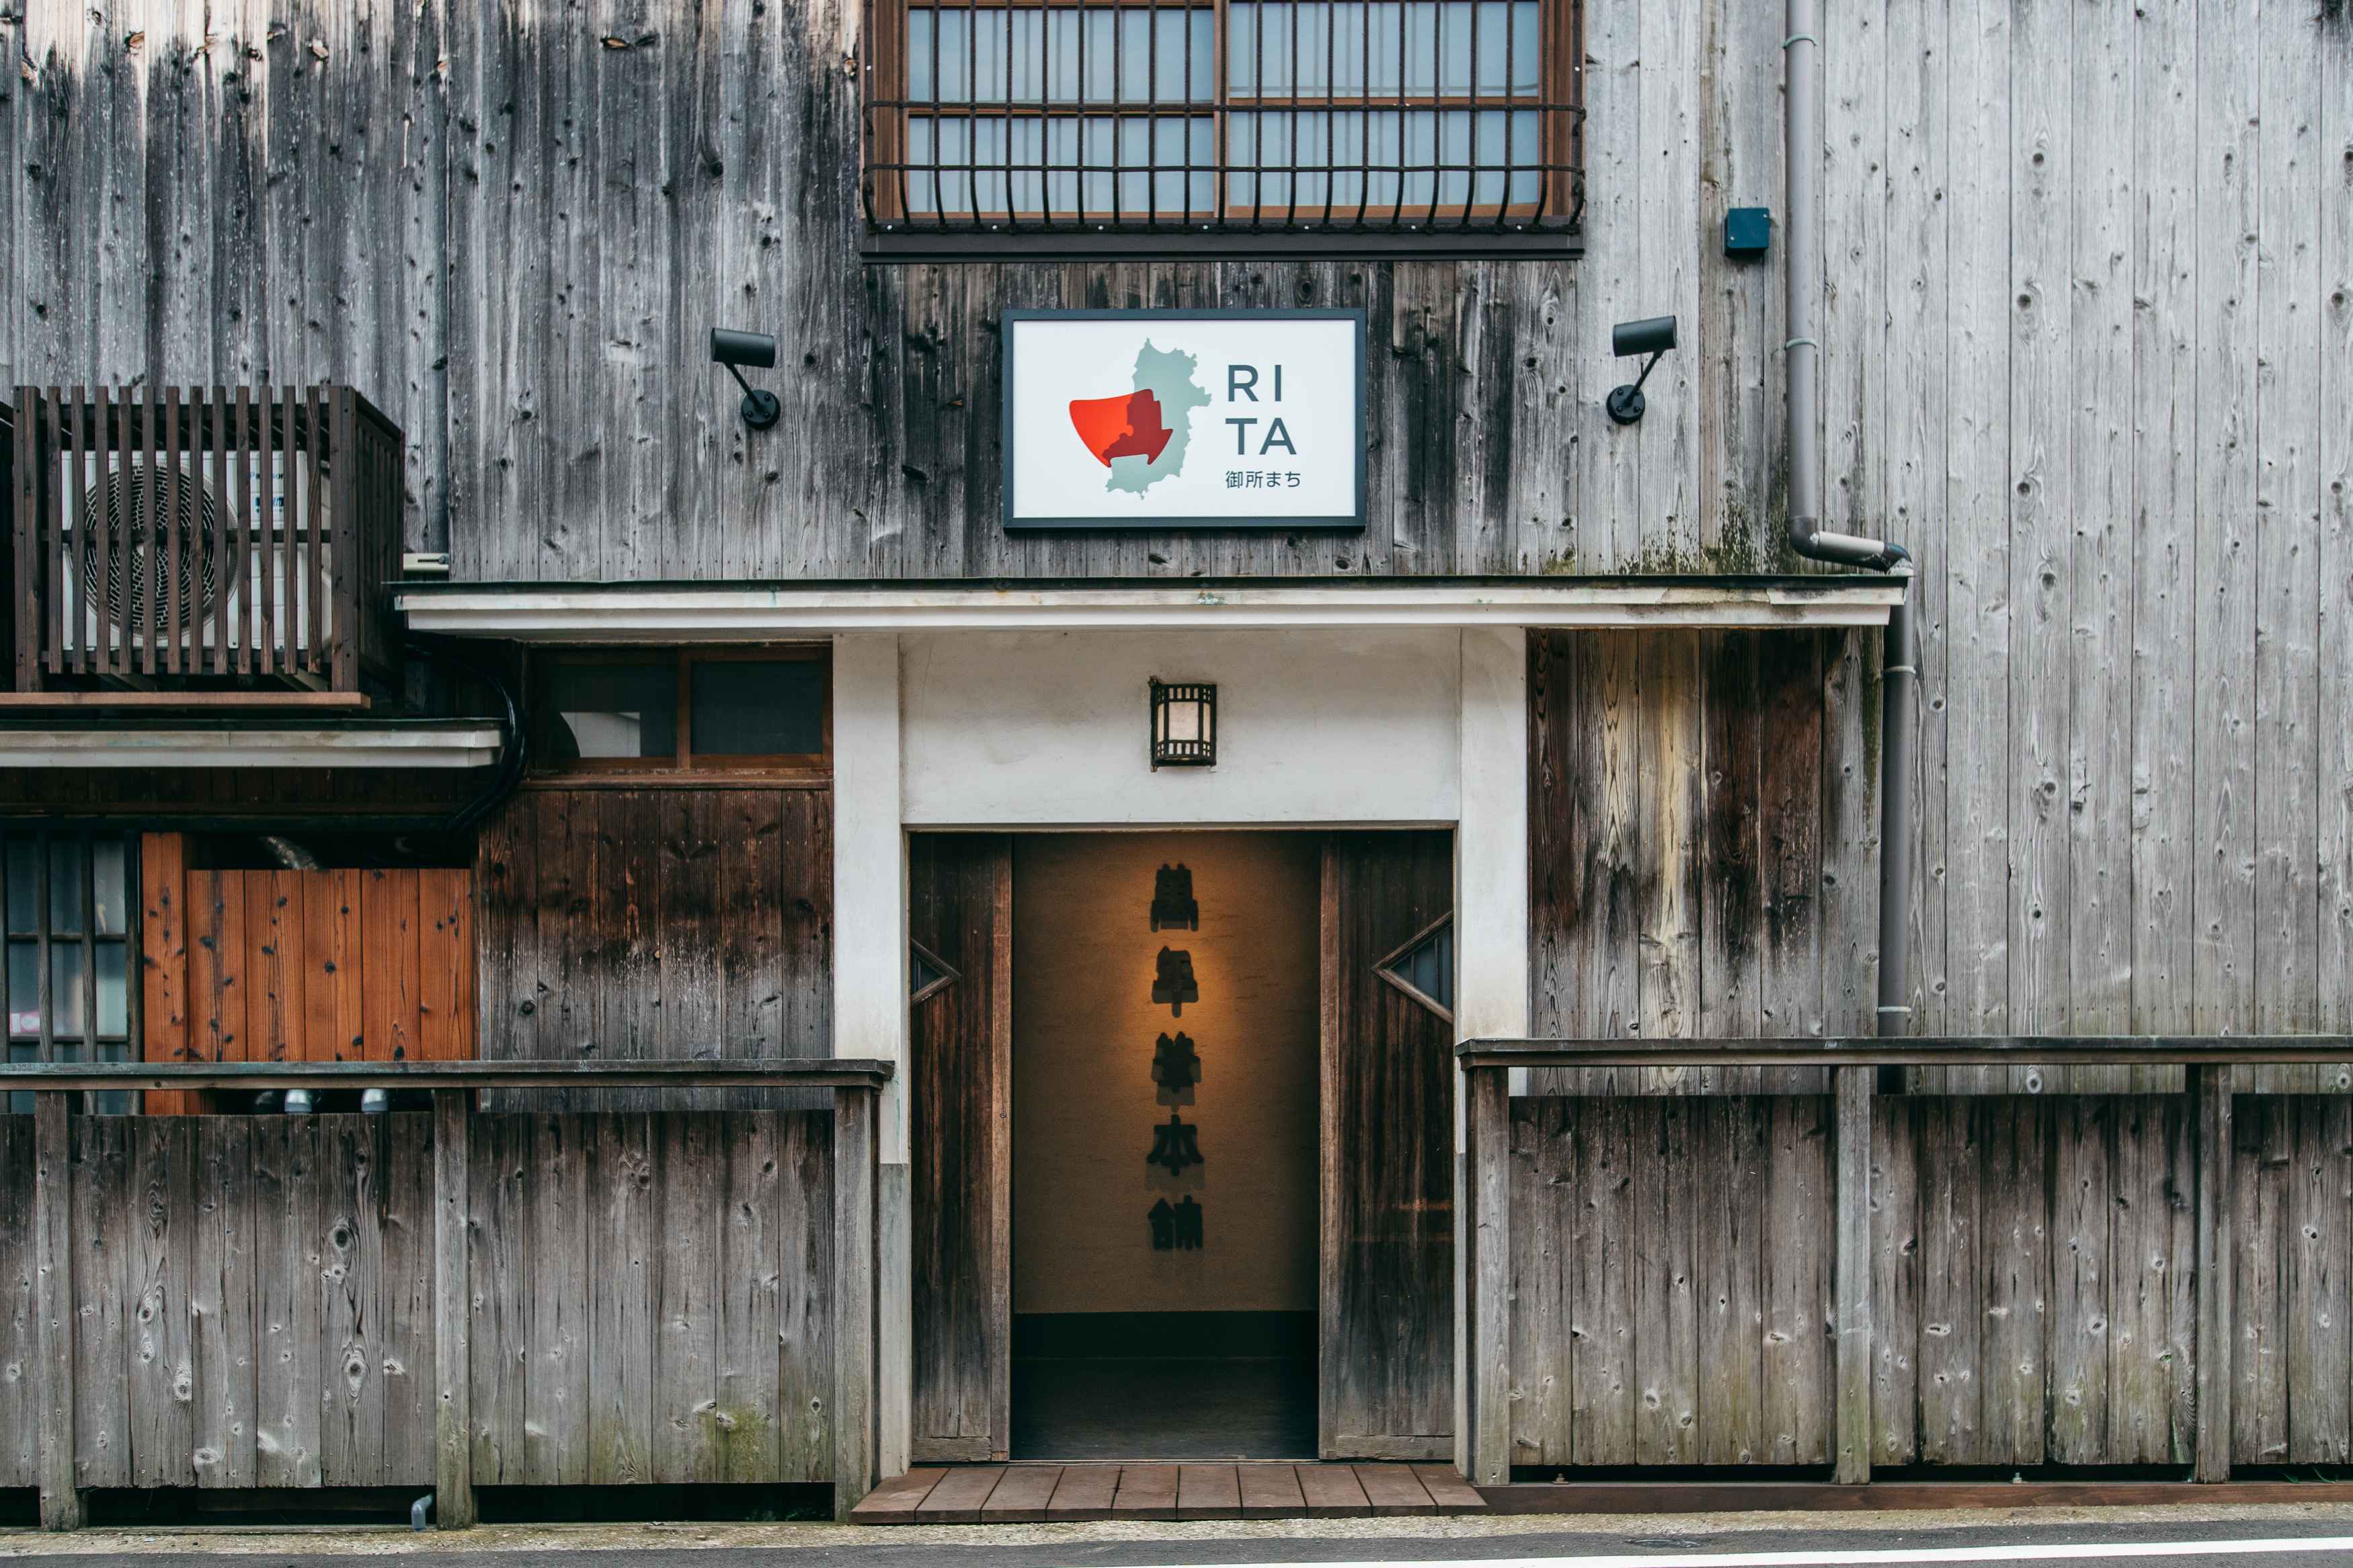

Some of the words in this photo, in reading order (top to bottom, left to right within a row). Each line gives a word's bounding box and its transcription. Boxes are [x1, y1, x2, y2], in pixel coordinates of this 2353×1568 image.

[1228, 364, 1282, 402] RI
[1225, 417, 1297, 455] TA
[1225, 470, 1301, 489] 御所まち
